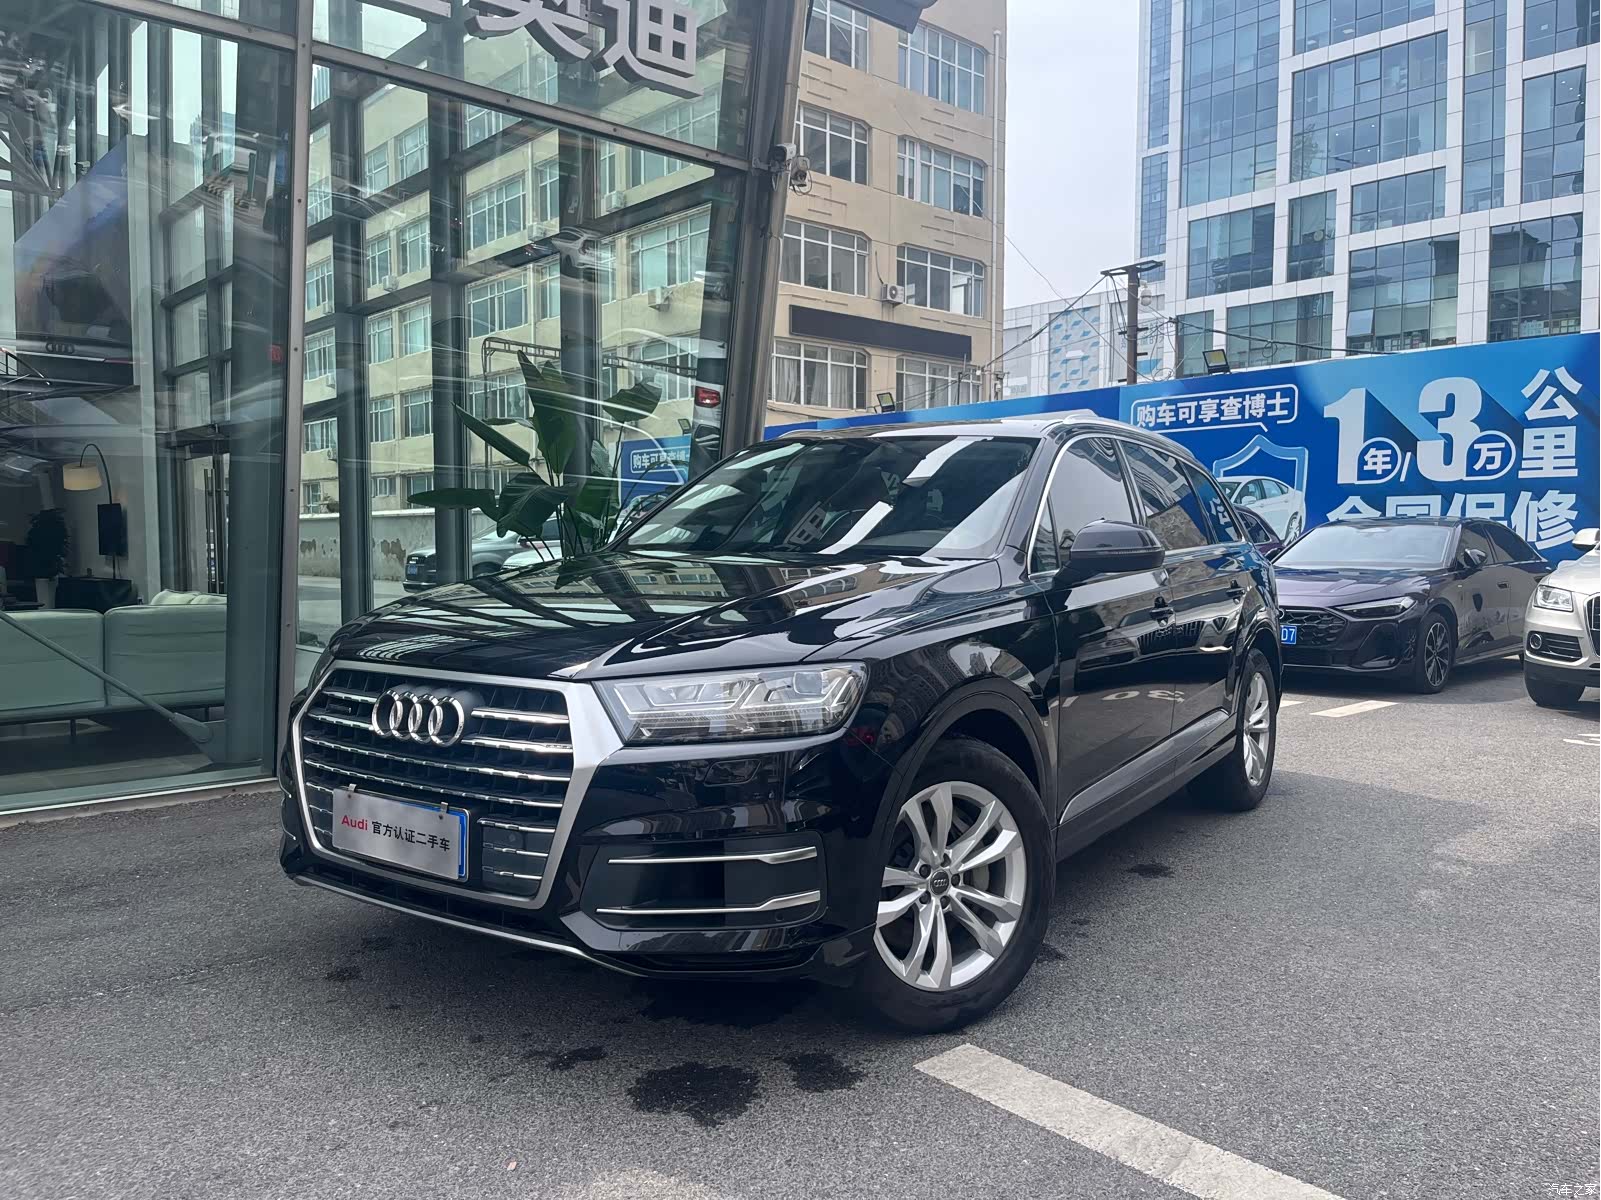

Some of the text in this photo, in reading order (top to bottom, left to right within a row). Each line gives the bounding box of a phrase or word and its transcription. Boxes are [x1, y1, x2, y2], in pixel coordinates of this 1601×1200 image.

[1137, 391, 1290, 427] 购车可享查博士
[341, 814, 451, 852] Audi 官方认证二手车
